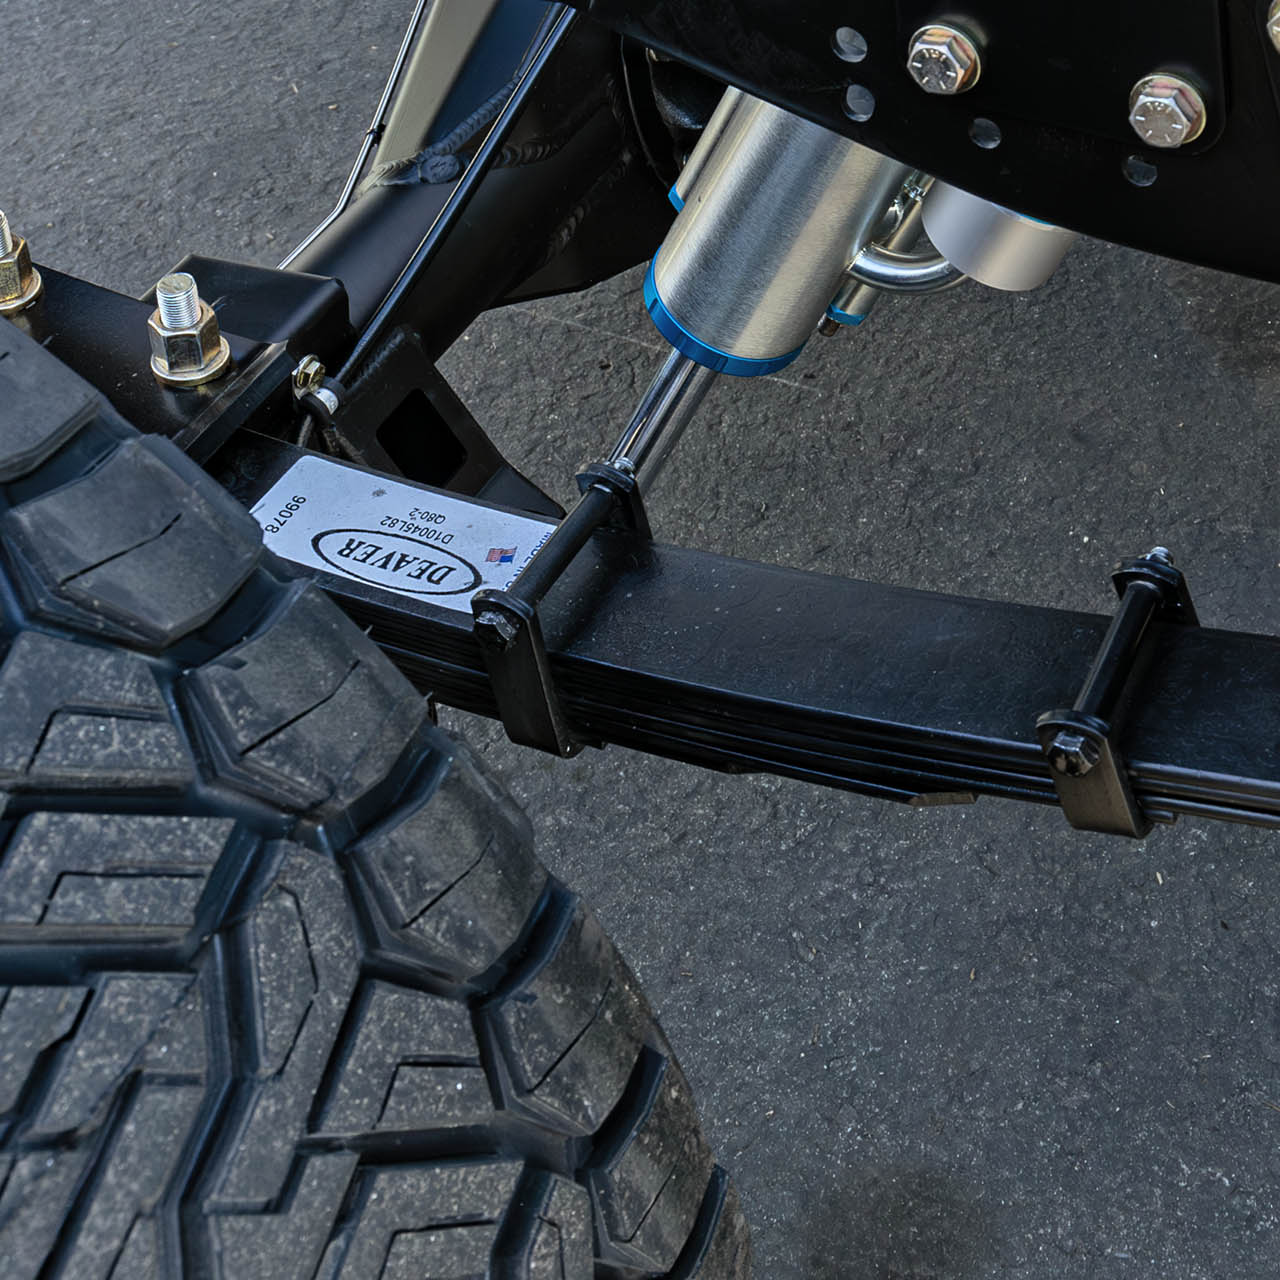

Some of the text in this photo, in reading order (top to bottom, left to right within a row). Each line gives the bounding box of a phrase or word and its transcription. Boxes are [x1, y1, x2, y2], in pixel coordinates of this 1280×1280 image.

[265, 495, 306, 534] 99078
[380, 515, 455, 545] D10045L82
[409, 507, 446, 525] Q80-2
[337, 538, 457, 585] DEAVER
